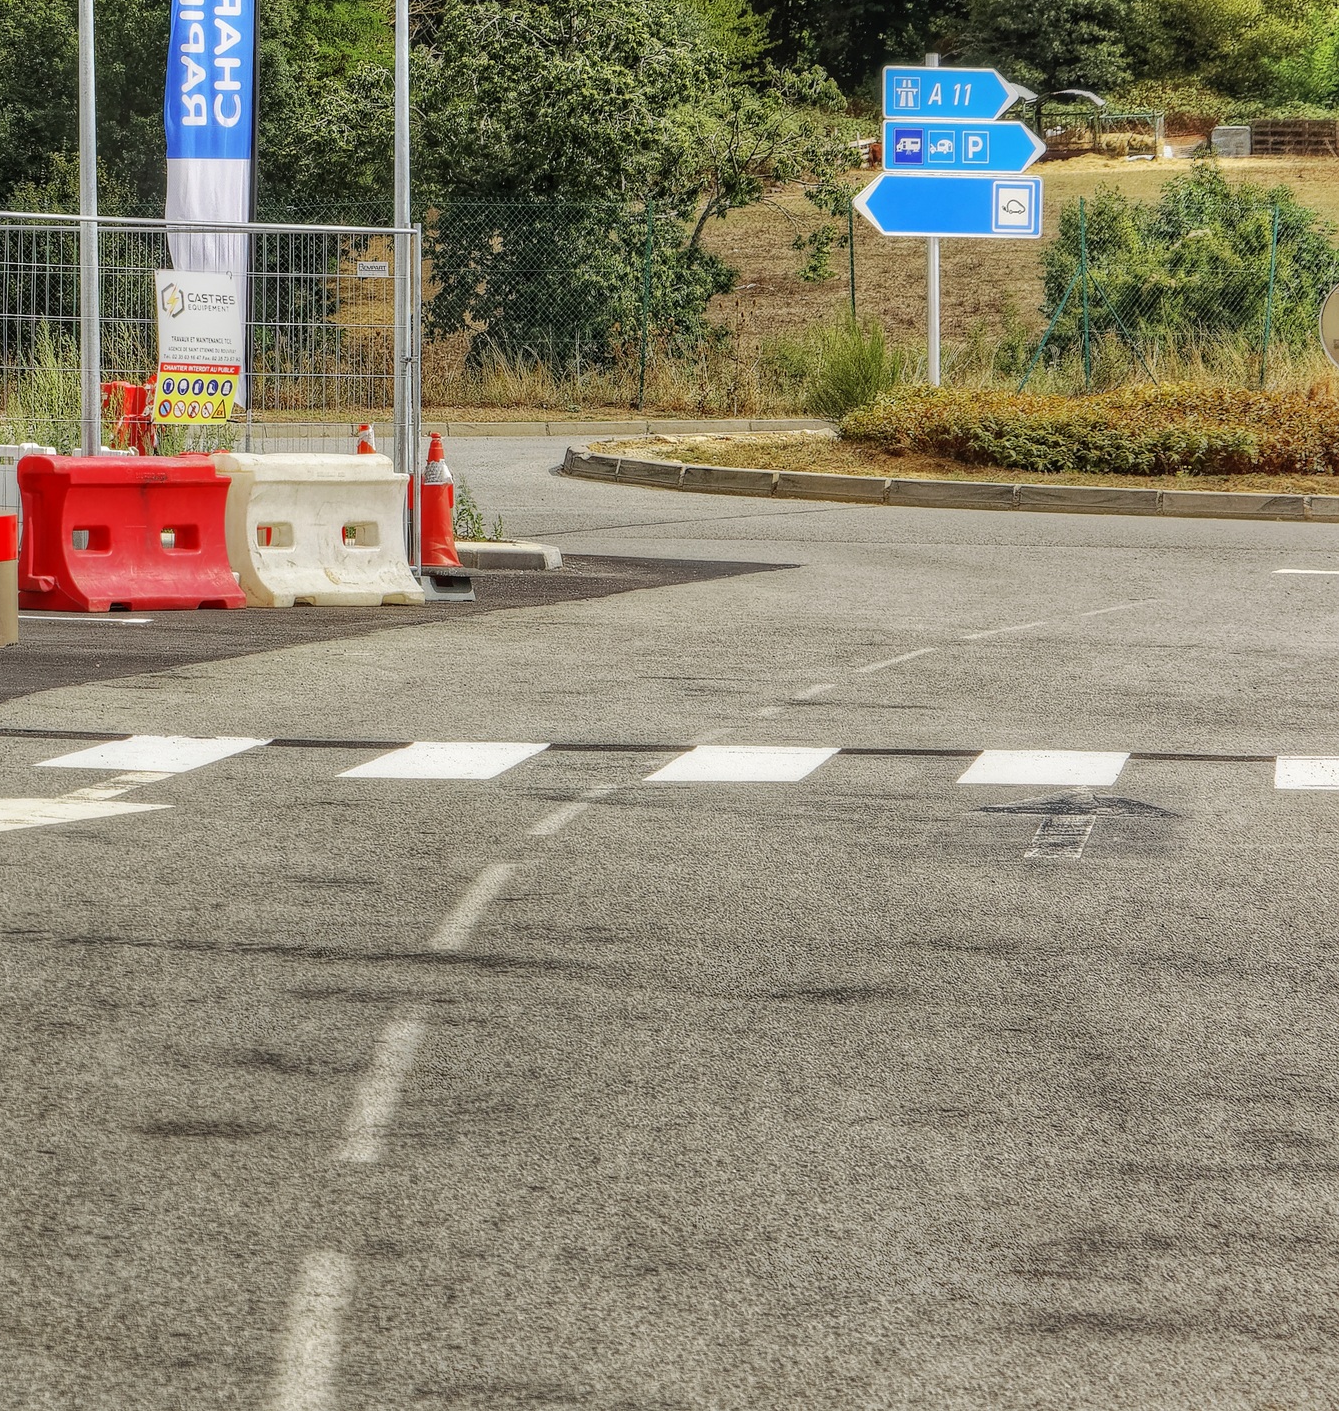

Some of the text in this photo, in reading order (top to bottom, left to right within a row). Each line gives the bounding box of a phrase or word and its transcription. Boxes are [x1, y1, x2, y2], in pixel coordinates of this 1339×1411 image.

[928, 83, 972, 106] A 11
[187, 293, 235, 305] CASTRES
[187, 304, 230, 313] EQUIPEMENT
